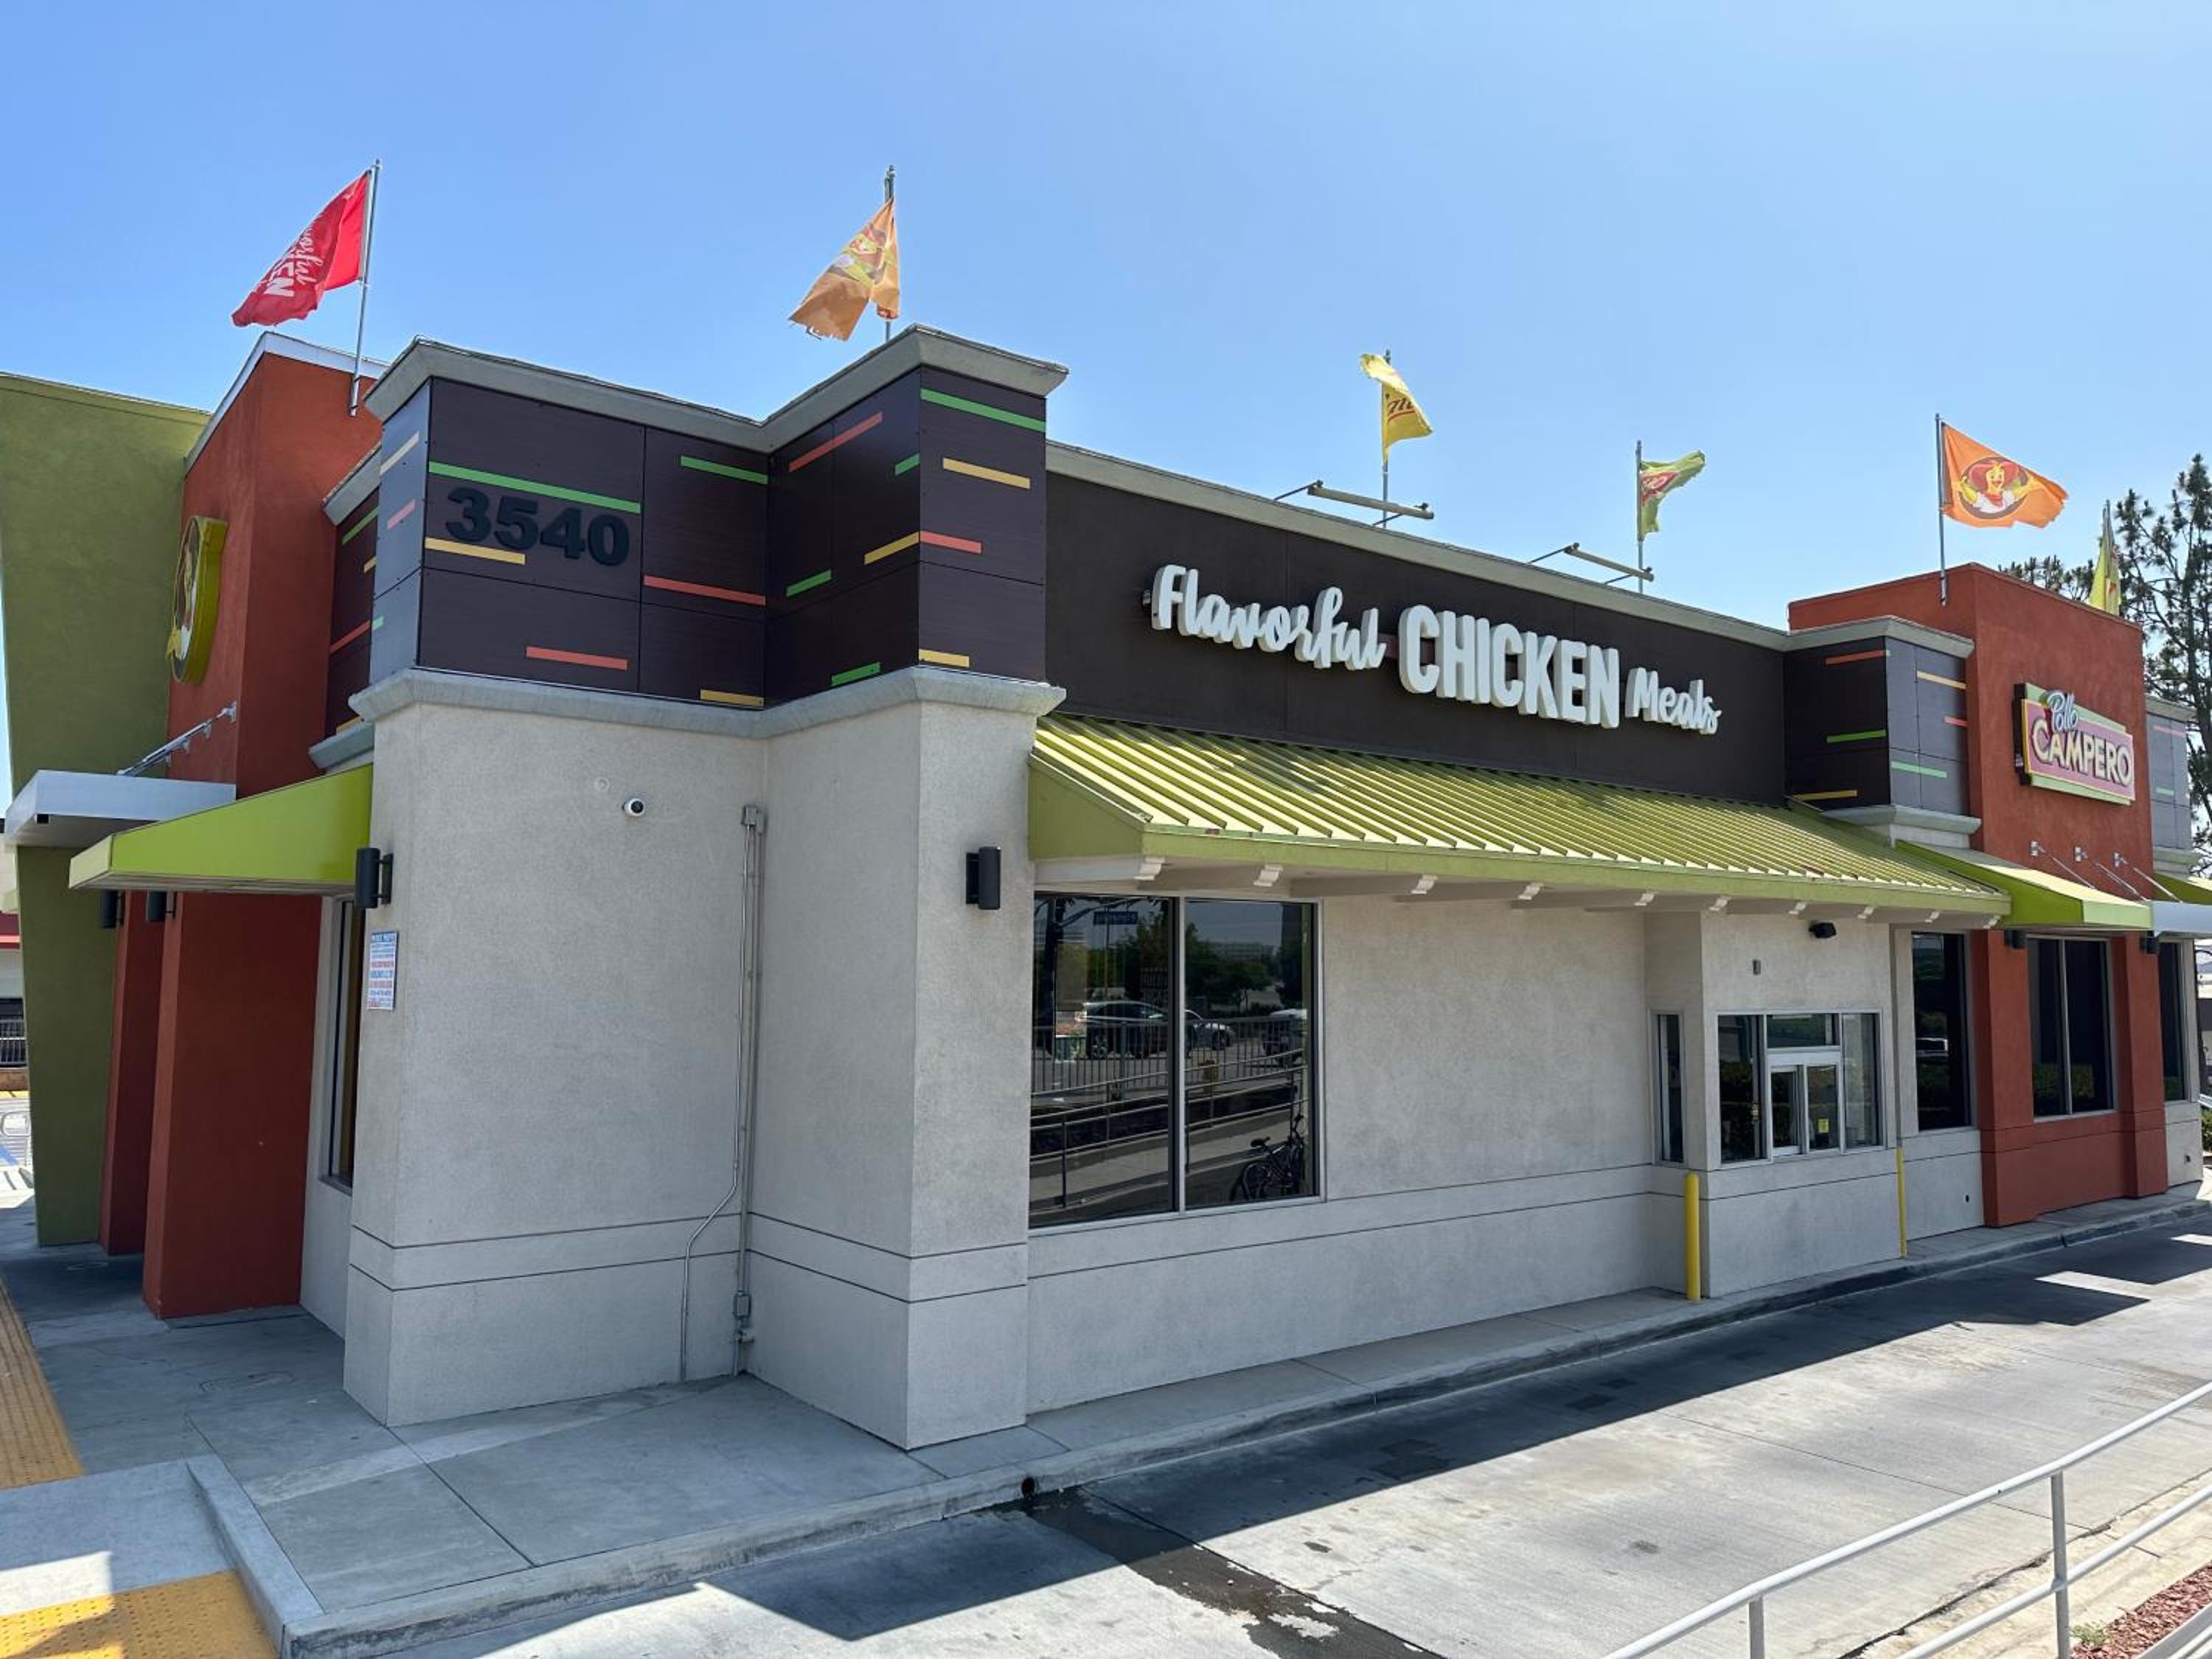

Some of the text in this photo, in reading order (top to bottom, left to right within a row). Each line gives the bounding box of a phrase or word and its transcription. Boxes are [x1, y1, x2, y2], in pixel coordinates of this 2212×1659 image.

[445, 487, 630, 566] 3540
[1152, 564, 1722, 734] Flavorful CHICKEN Meals
[2046, 689, 2079, 732] Pollo
[2031, 717, 2132, 787] CAMPERO
